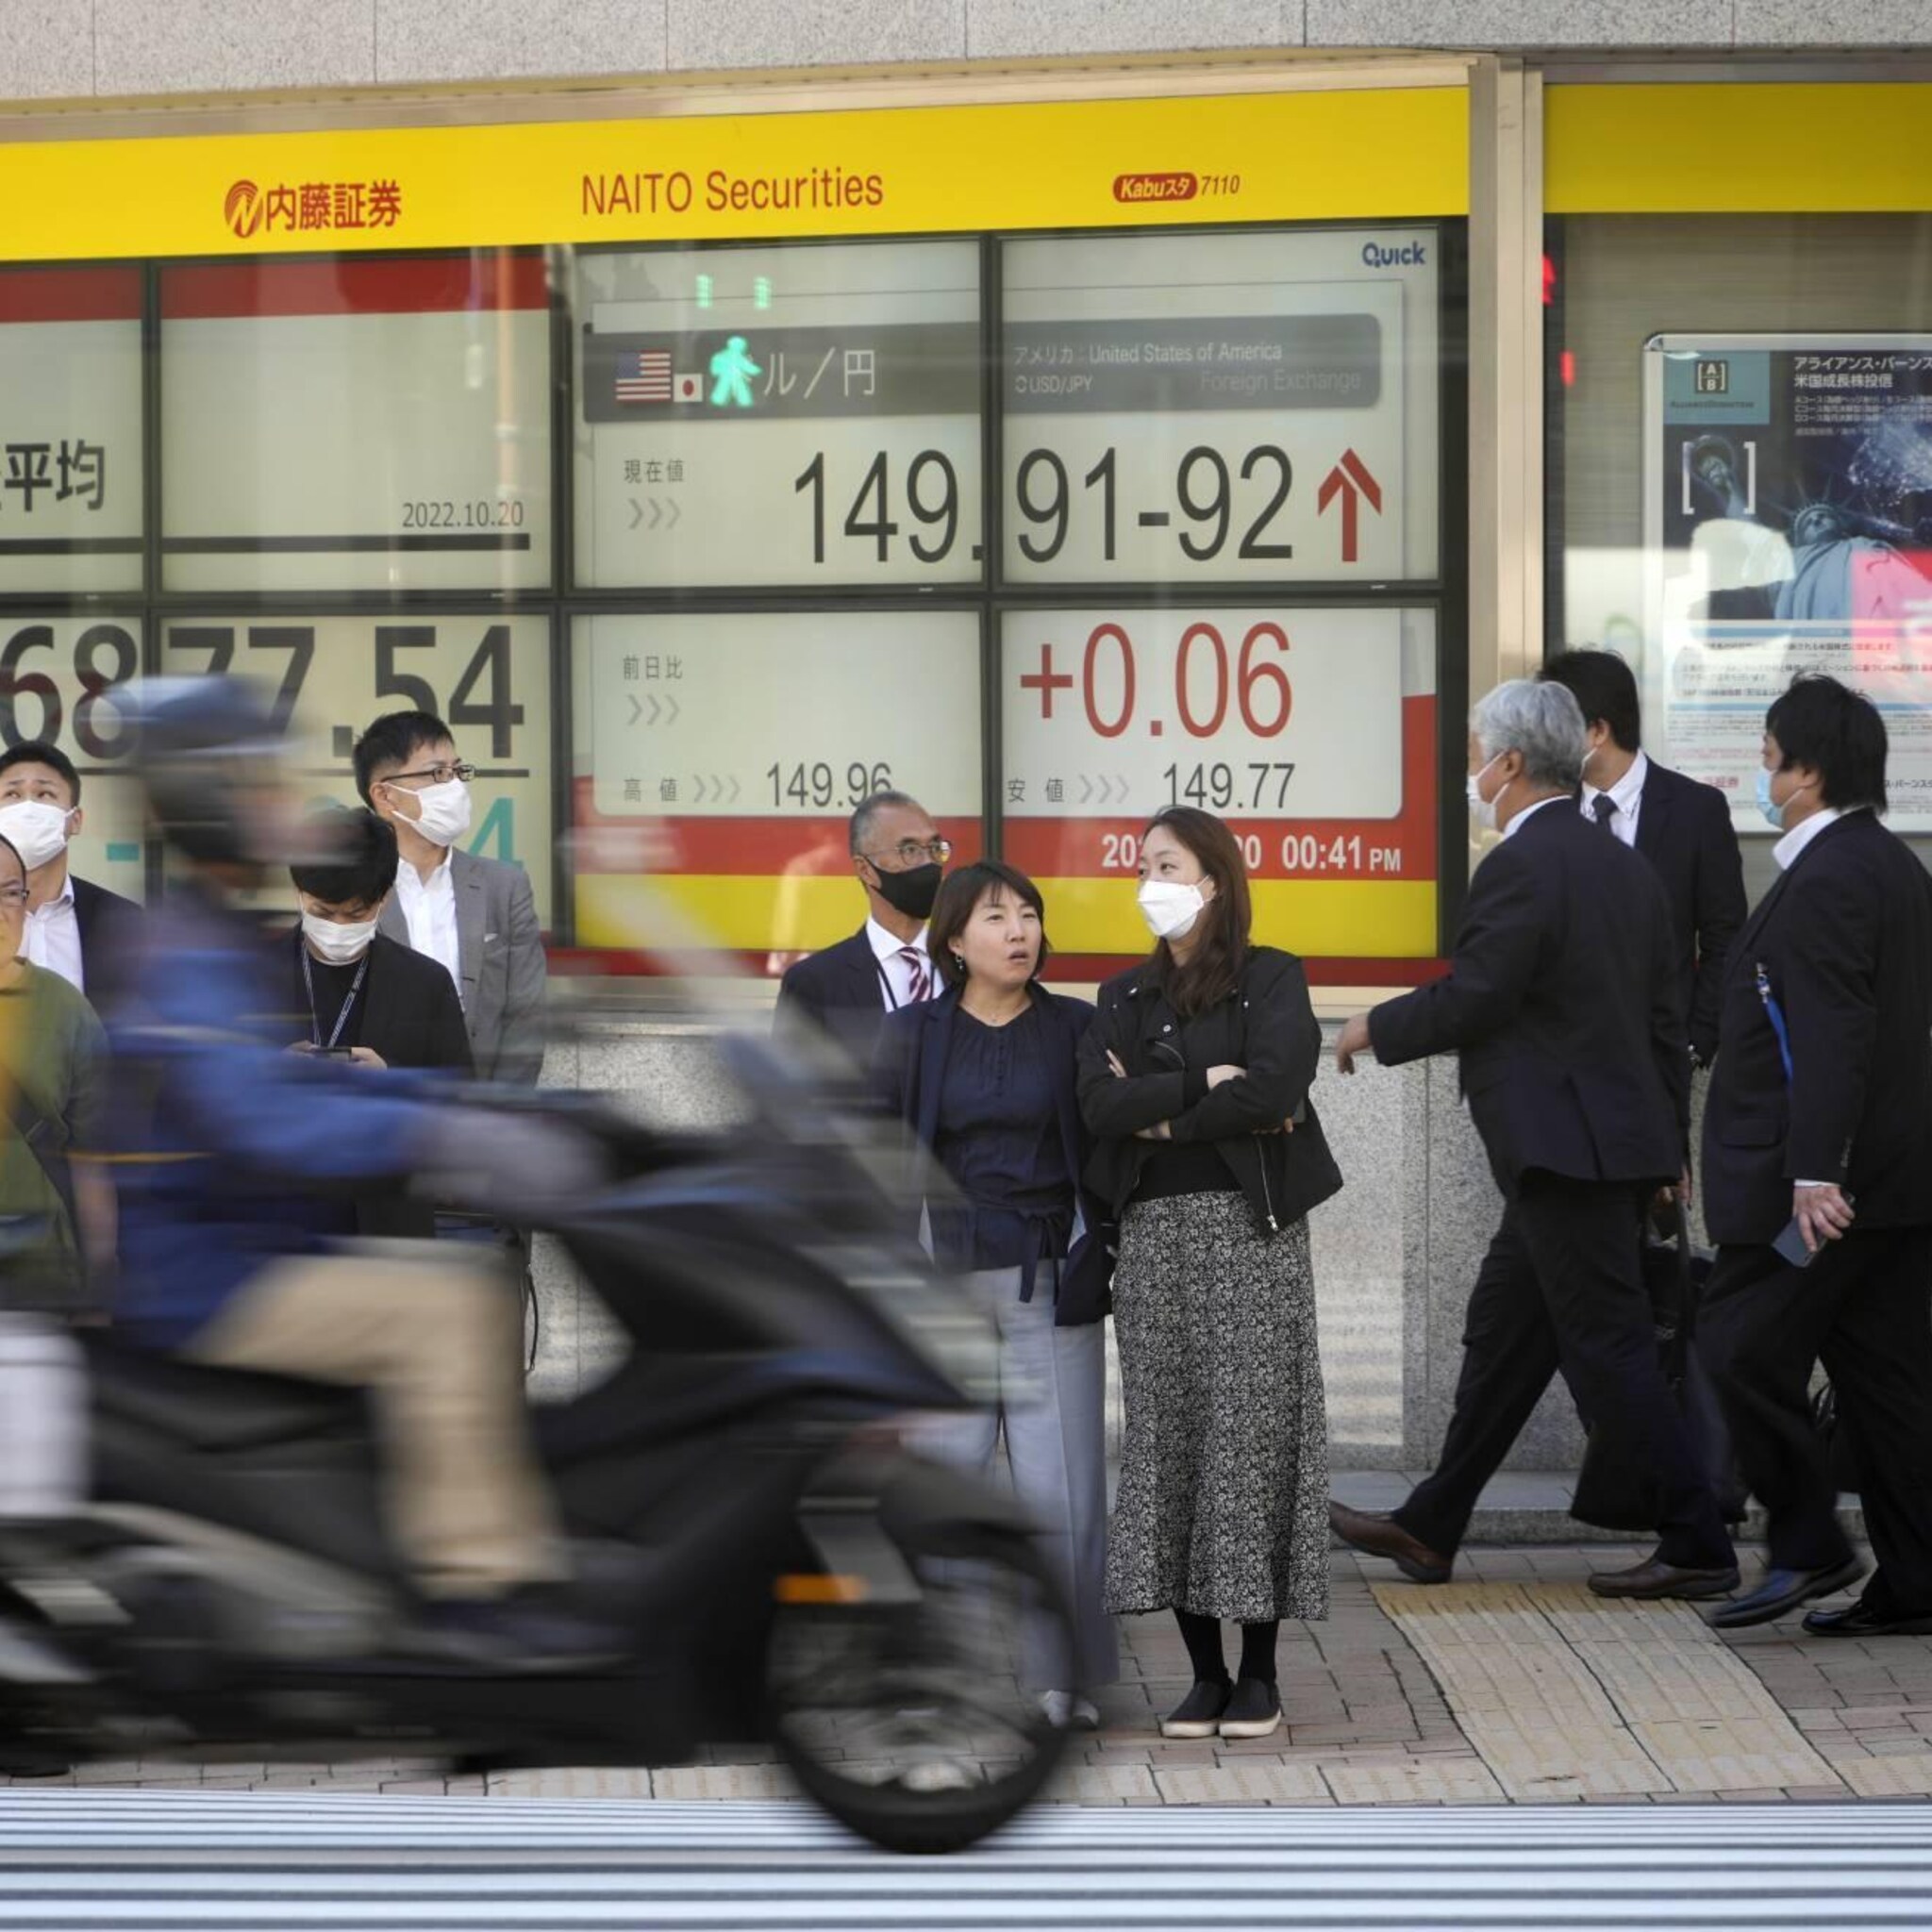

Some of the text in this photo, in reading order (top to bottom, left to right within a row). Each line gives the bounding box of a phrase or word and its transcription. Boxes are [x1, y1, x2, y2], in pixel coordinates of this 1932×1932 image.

[581, 166, 884, 216] NAITO Securities
[1121, 175, 1241, 199] Kabuスタ 7110
[265, 179, 402, 232] 内藤証券
[1090, 343, 1140, 364] United
[1144, 342, 1193, 363] States
[1196, 341, 1214, 361] of
[1219, 341, 1283, 361] America
[624, 458, 685, 484] 現在値
[402, 500, 525, 528] 2022.10.20
[623, 655, 683, 680] 前日比
[1020, 623, 1292, 739] +0.06
[1163, 762, 1295, 809] 149.77
[1281, 835, 1361, 871] 00:41
[1370, 848, 1401, 872] PM
